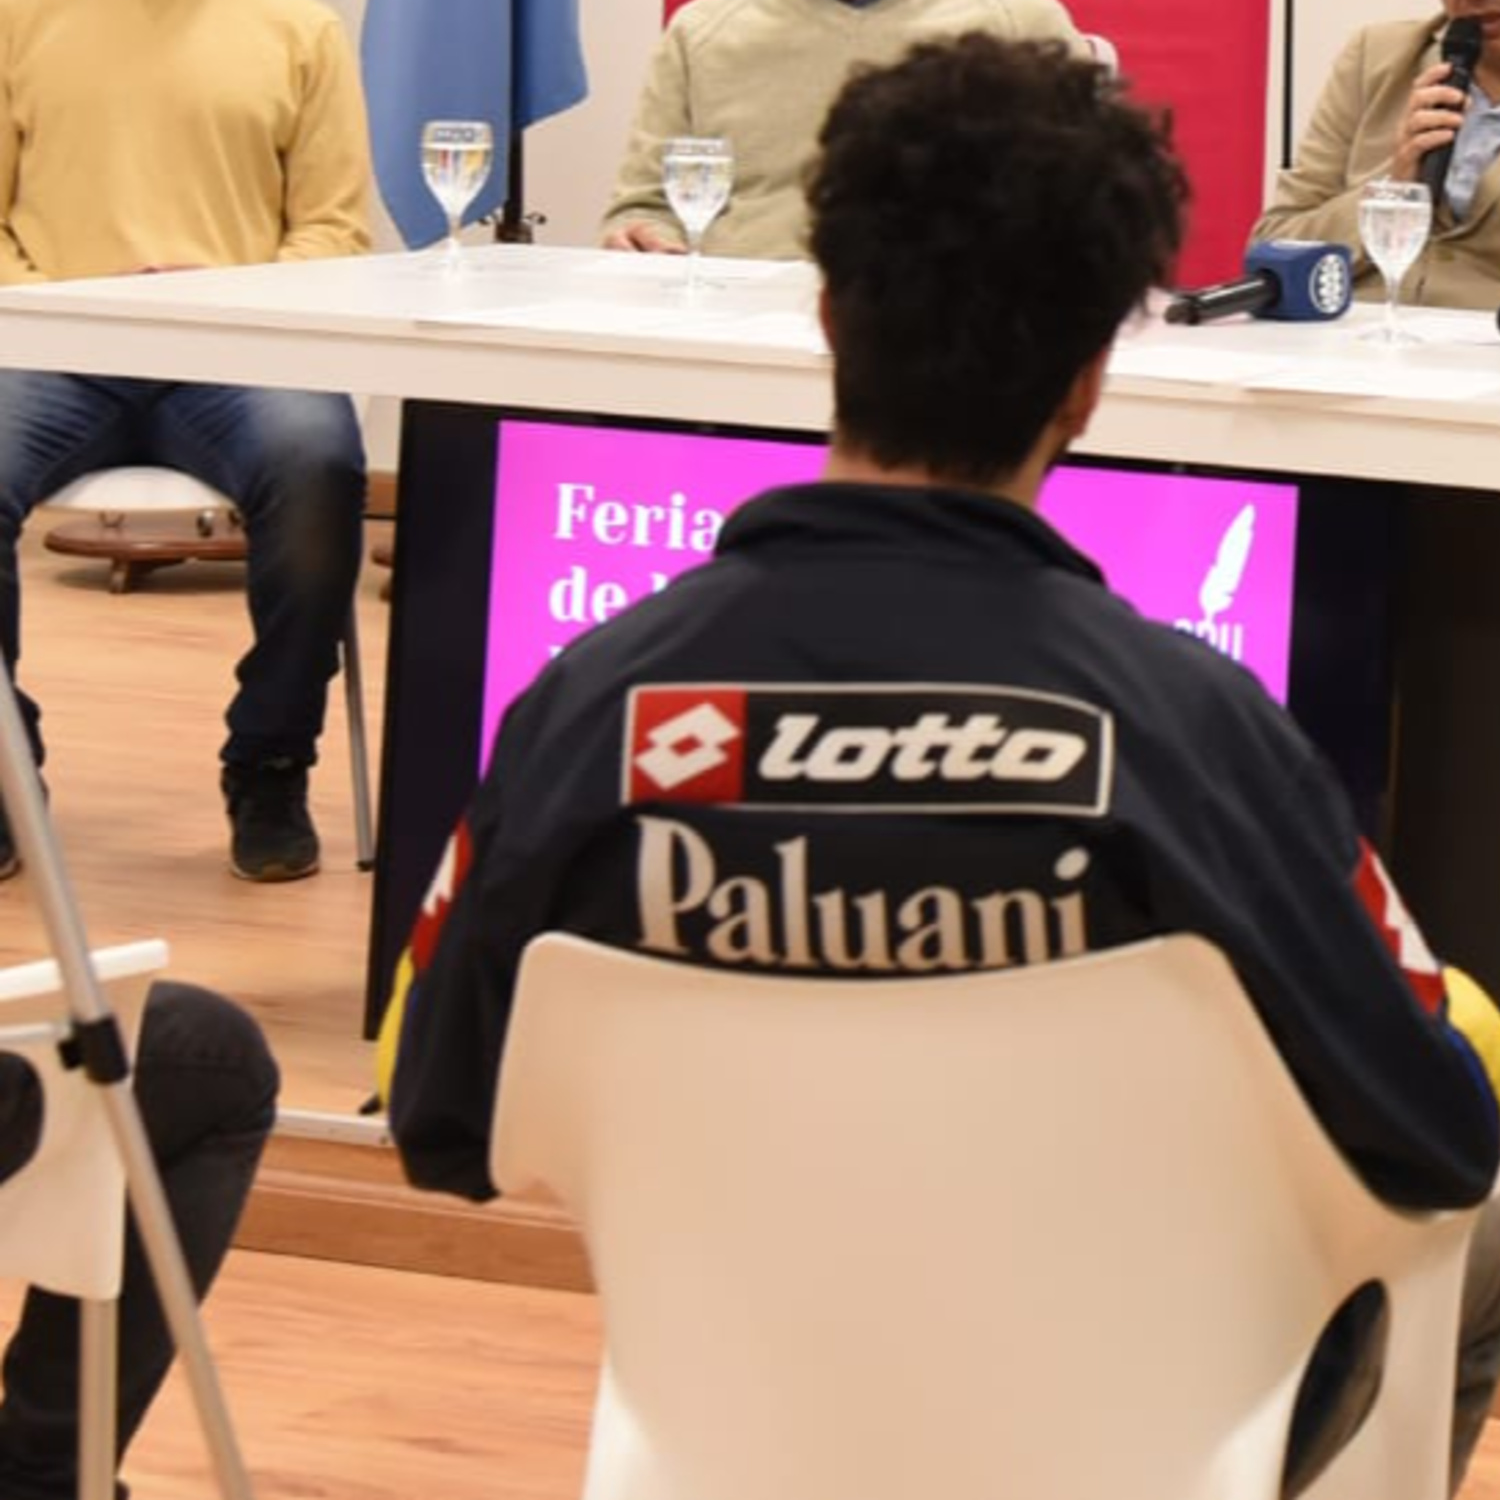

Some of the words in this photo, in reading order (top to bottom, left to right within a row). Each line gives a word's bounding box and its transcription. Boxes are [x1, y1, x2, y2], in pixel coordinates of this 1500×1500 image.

[553, 482, 725, 553] Feria
[548, 565, 628, 624] de
[758, 714, 1087, 781] lotto
[635, 815, 1090, 970] Paluani
